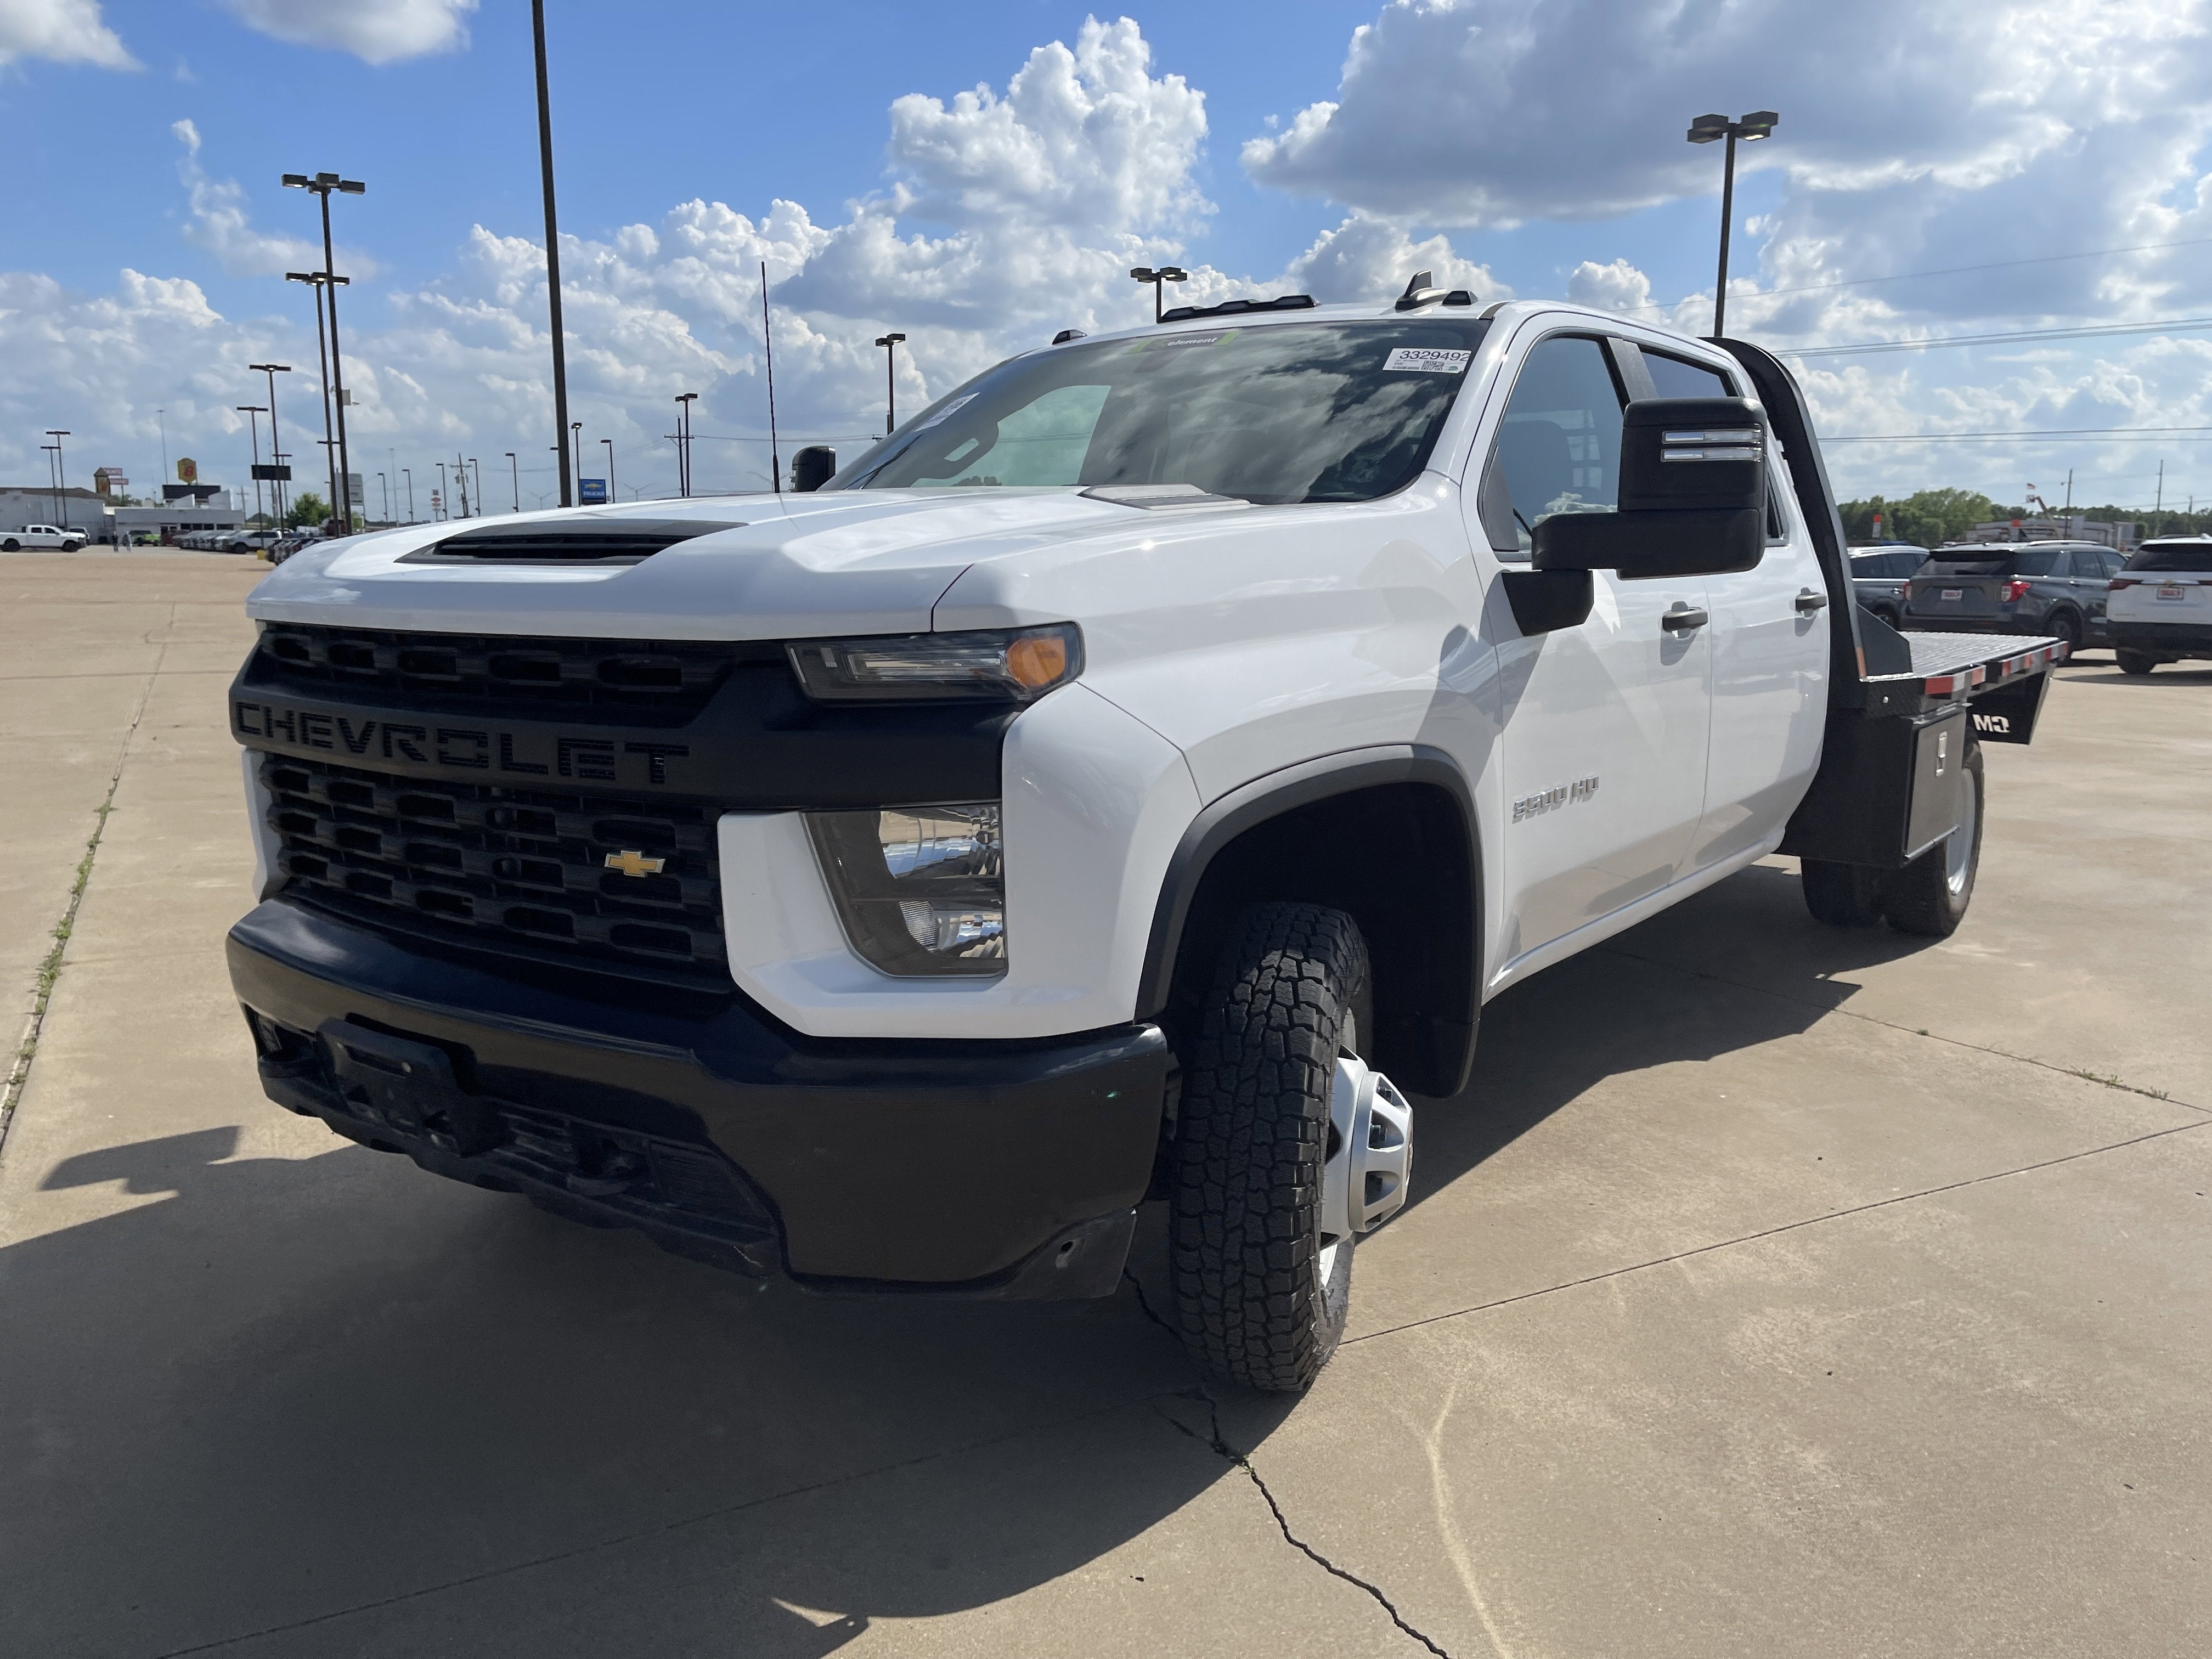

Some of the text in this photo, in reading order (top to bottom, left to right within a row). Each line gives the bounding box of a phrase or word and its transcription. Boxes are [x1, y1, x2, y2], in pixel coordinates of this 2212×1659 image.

[1167, 337, 1217, 346] element
[1400, 350, 1470, 362] 3329492
[235, 702, 690, 784] CHEVROLET
[1572, 775, 1599, 798] HD
